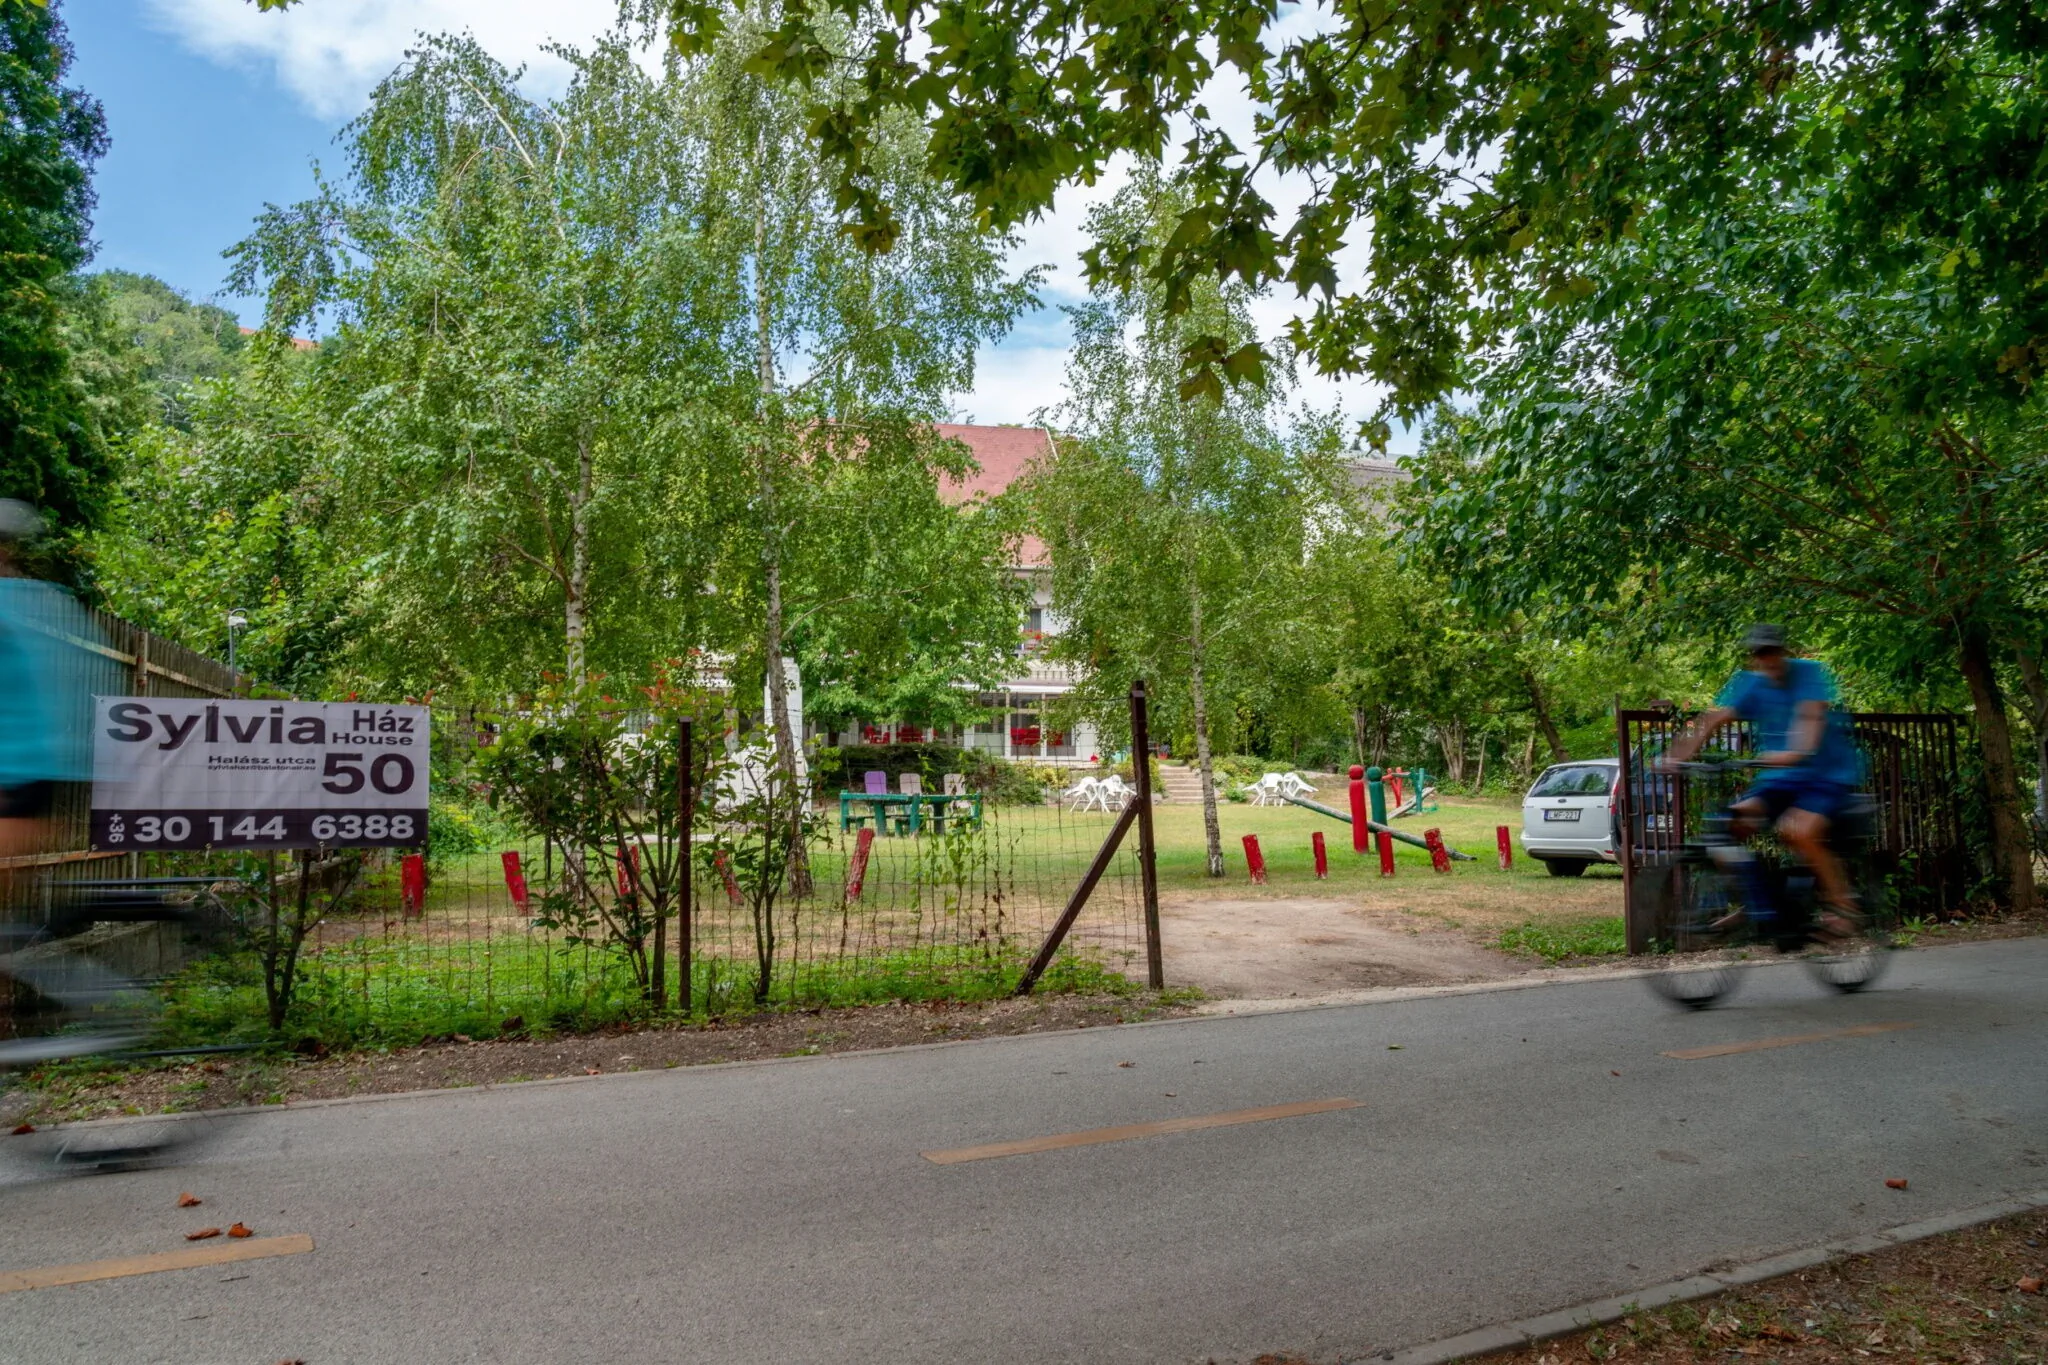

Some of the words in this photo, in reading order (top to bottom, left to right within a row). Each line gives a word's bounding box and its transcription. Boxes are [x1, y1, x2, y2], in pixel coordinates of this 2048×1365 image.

[106, 703, 326, 750] Sylvia
[353, 710, 414, 733] Ház
[332, 733, 414, 746] House
[208, 755, 270, 764] Halász
[322, 753, 415, 795] 50
[108, 814, 125, 843] +36
[134, 816, 191, 842] 30
[208, 816, 287, 841] 144
[311, 815, 414, 840] 6388
